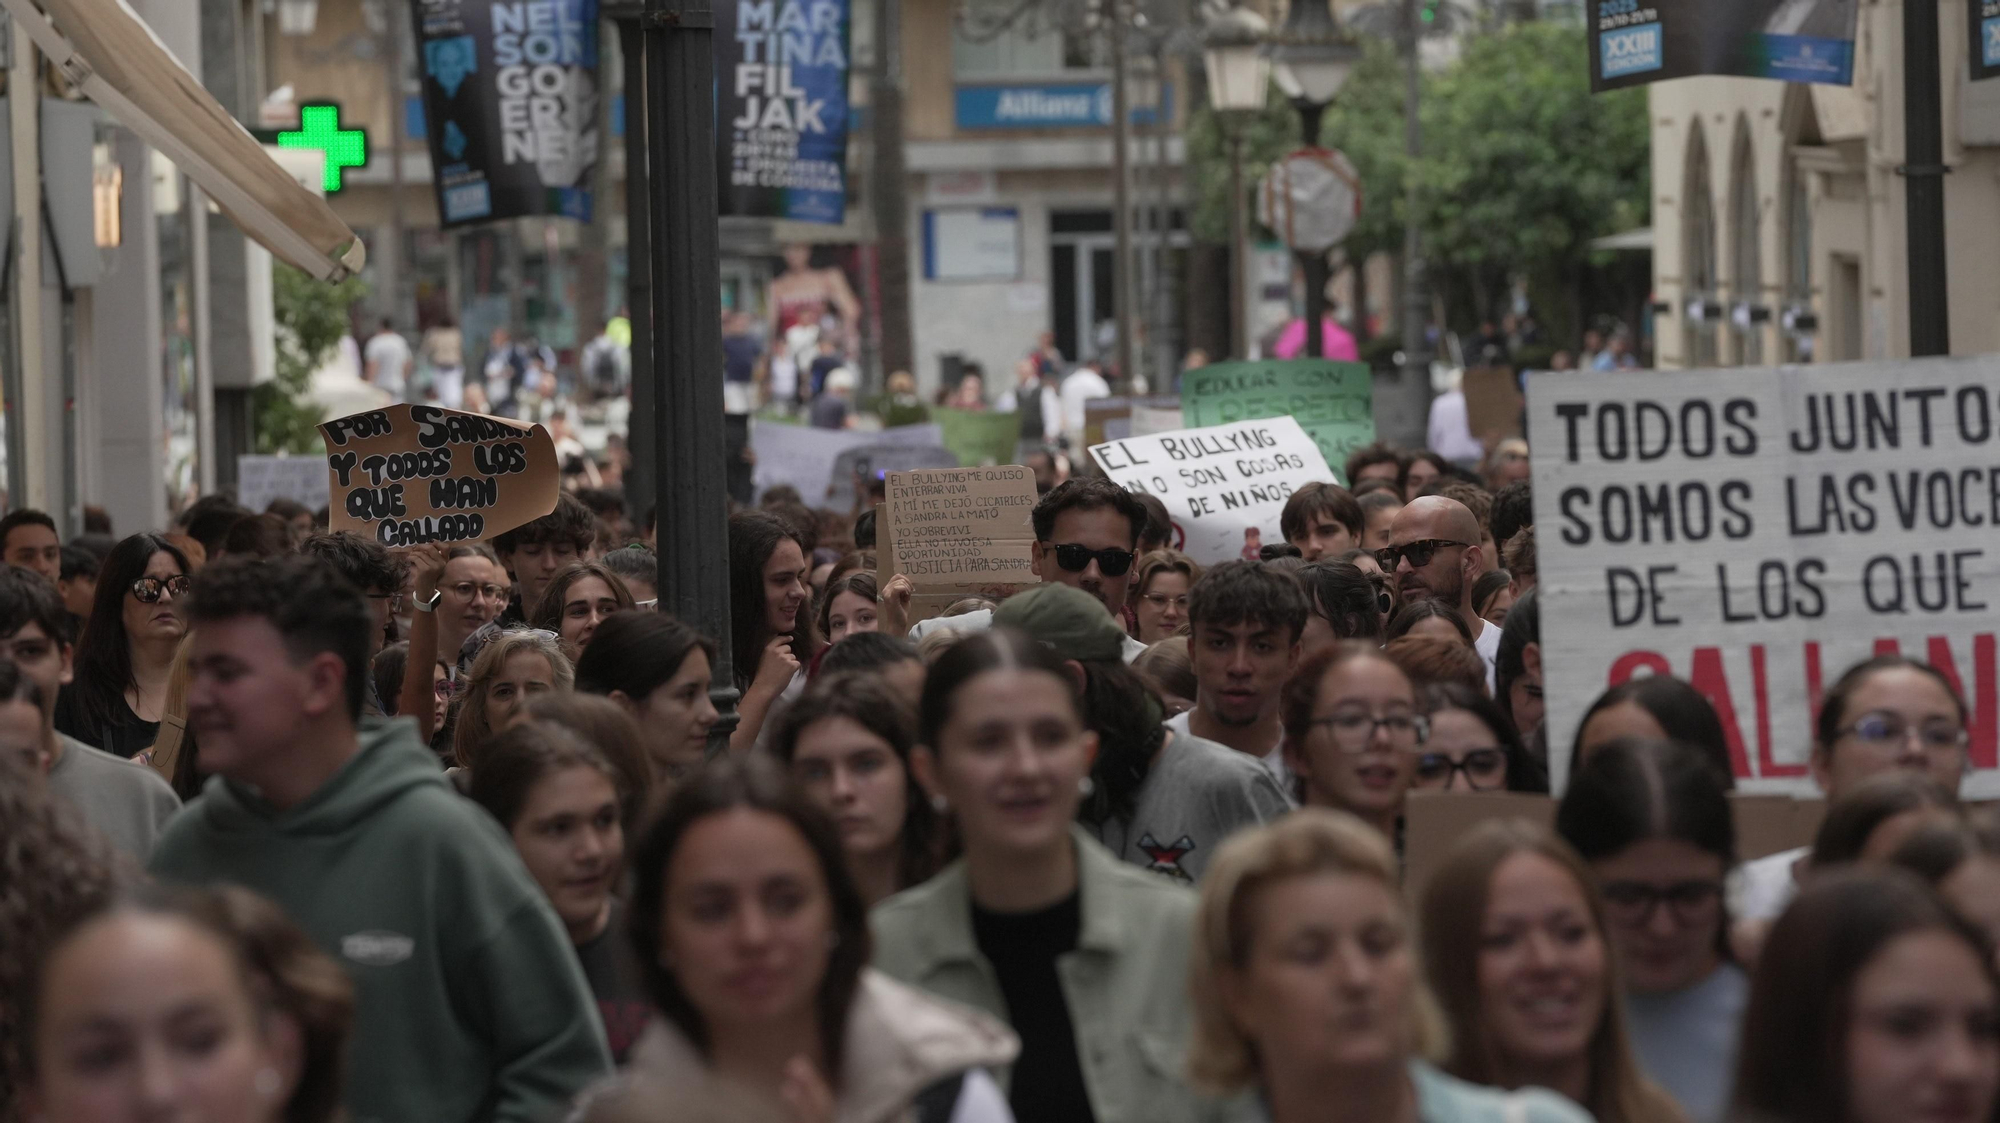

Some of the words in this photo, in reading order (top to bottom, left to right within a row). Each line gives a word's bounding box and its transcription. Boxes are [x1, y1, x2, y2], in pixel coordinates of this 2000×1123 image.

[491, 2, 582, 33] NEL
[737, 0, 841, 34] MAR
[735, 31, 847, 69] TINA
[1606, 30, 1656, 58] XXIII
[497, 64, 566, 97] GO
[735, 63, 807, 98] FIL
[500, 97, 568, 130] ER
[732, 96, 827, 135] JAK
[996, 88, 1090, 120] Allianz
[321, 410, 393, 447] POR
[1554, 398, 1760, 464] TODOS
[1789, 385, 2000, 455] JUNTO
[329, 450, 357, 488] Y
[361, 446, 453, 487] TODOS
[472, 442, 528, 476] LOS
[1095, 442, 1150, 472] EL
[1159, 428, 1278, 461] BULLYNG
[891, 474, 906, 487] EL
[911, 473, 966, 486] BULLYING
[968, 471, 982, 482] ME
[985, 469, 1024, 482] QUISO
[1179, 464, 1228, 490] SON
[1236, 453, 1305, 478] COSAS
[345, 484, 408, 522] QUE
[893, 501, 901, 513] A
[922, 500, 939, 510] ME
[975, 495, 1033, 507] CICATRICES
[945, 484, 968, 495] VIVA
[894, 514, 902, 526] A
[905, 511, 948, 524] SANDRA
[1187, 497, 1215, 519] DE
[1559, 479, 1754, 546] SOMOS
[1785, 472, 1878, 537] LAS
[896, 528, 911, 538] YO
[897, 540, 922, 550] ELLA
[925, 539, 940, 549] NO
[971, 537, 992, 548] ESA
[898, 548, 981, 561] OPORTUNIDAD
[901, 560, 963, 576] JUSTICIA
[964, 558, 990, 573] PARA
[1605, 564, 1682, 629] DE
[1716, 558, 1827, 624] LOS
[1861, 549, 1989, 616] QUE
